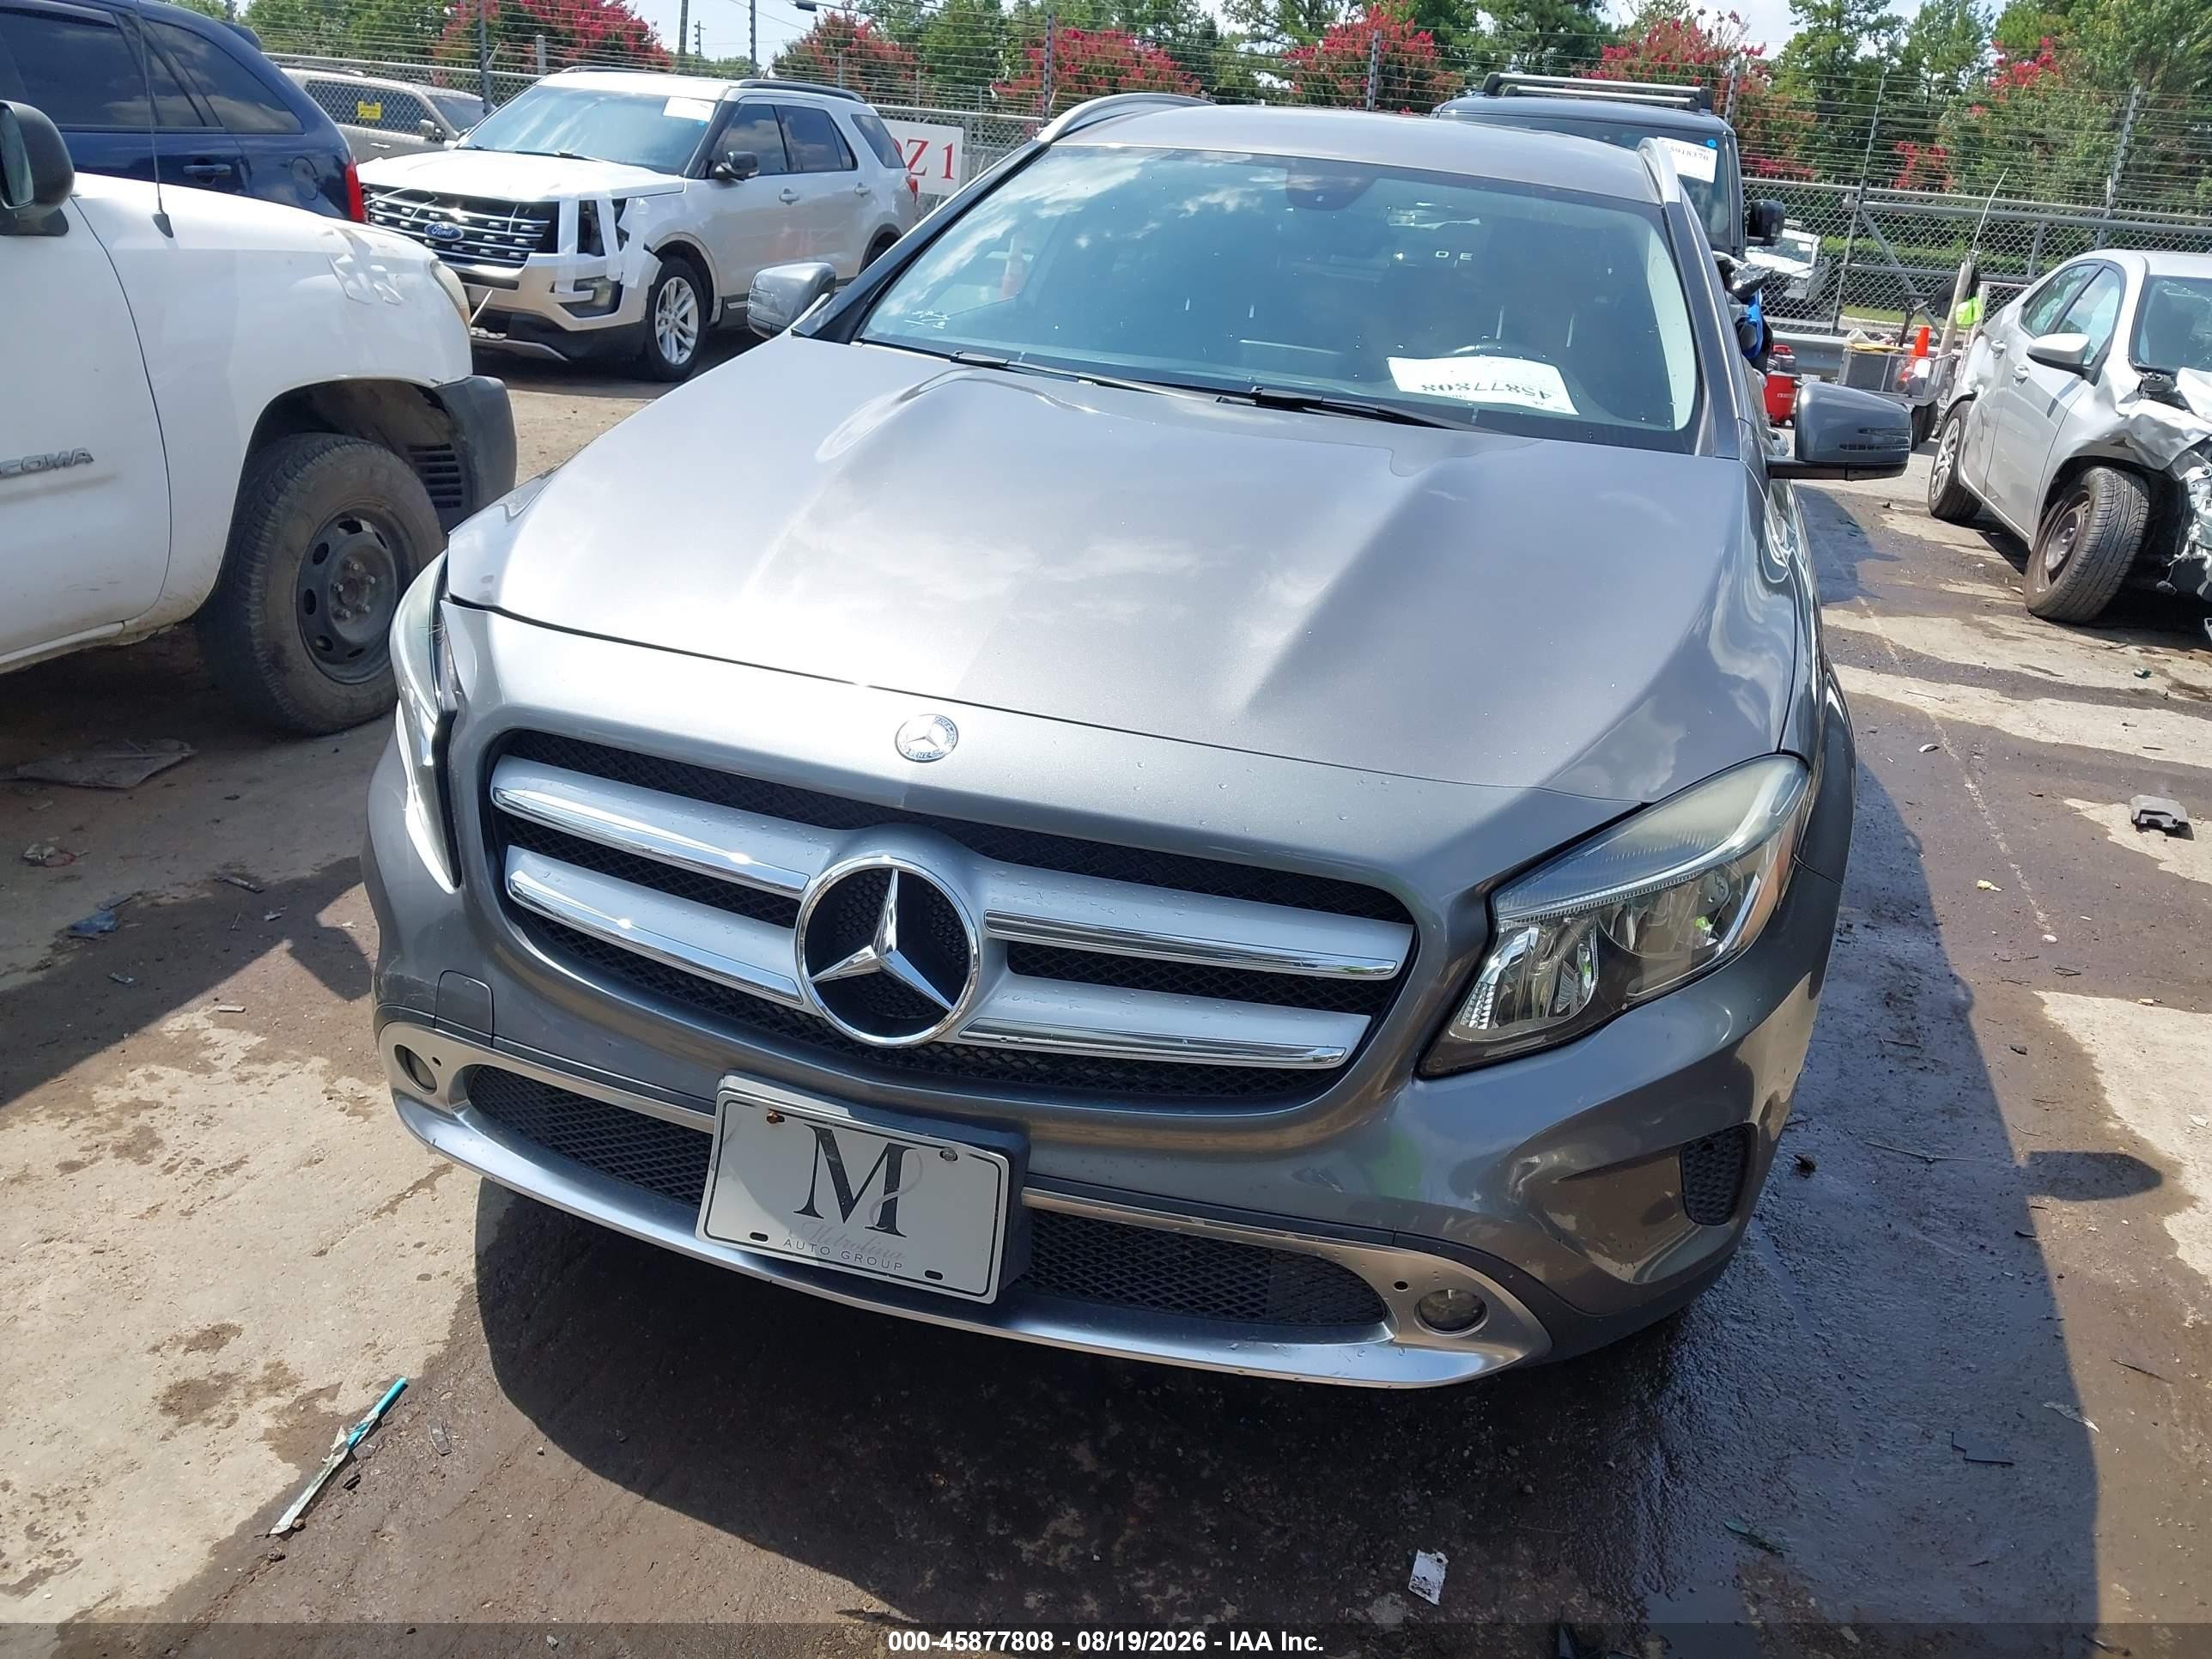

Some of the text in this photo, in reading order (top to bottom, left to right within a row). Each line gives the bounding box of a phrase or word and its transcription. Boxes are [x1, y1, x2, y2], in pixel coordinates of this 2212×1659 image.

[893, 137, 955, 180] Z 1
[431, 225, 454, 236] Ford
[1421, 382, 1552, 399] 45877808
[783, 1237, 903, 1271] AUTO GROUP
